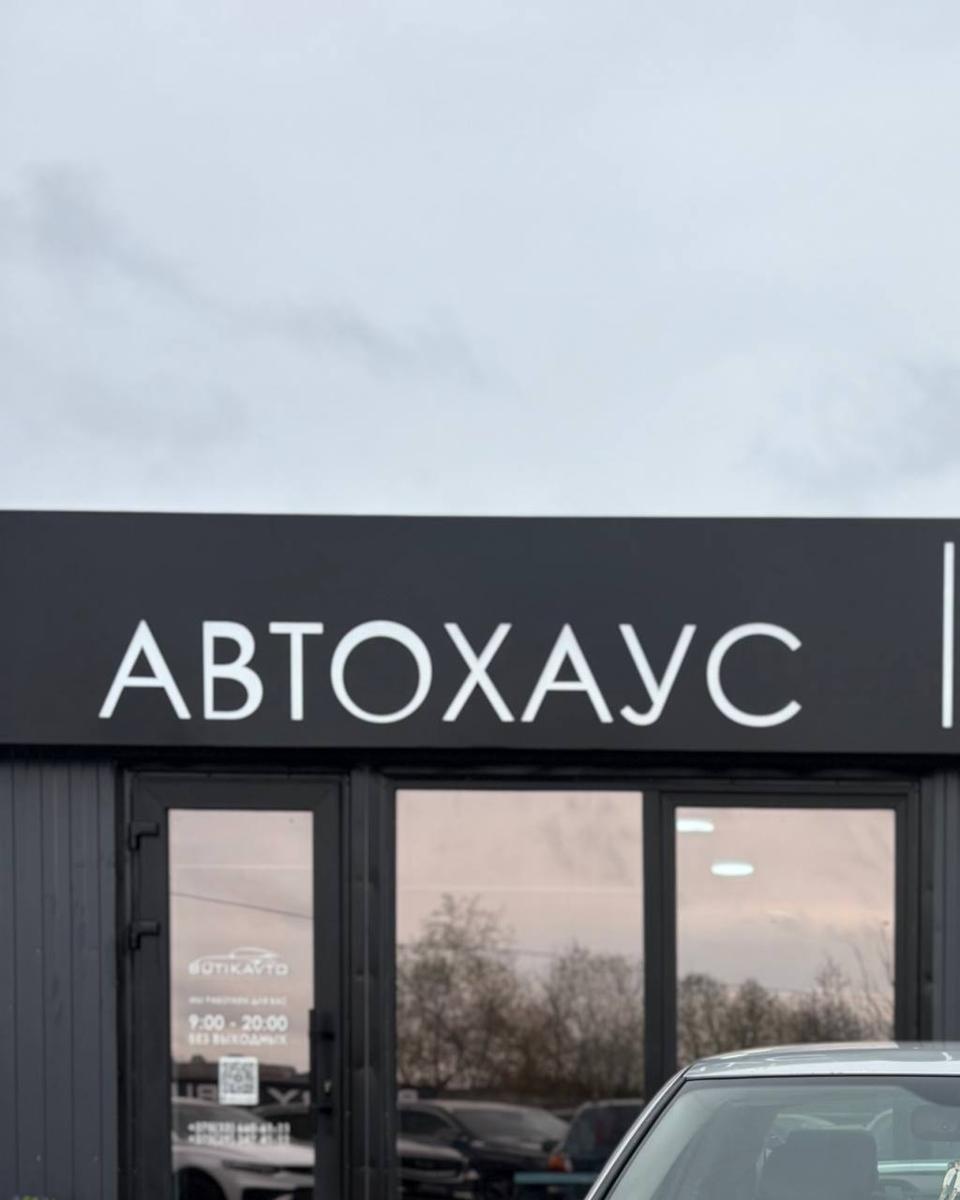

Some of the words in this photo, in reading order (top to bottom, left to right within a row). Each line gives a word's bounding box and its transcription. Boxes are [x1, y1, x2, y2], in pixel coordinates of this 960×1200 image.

[98, 618, 803, 727] АВТОХАУС
[188, 961, 289, 976] BUTIKAVTO
[188, 1014, 225, 1031] 9:00
[241, 1014, 288, 1032] 20:00
